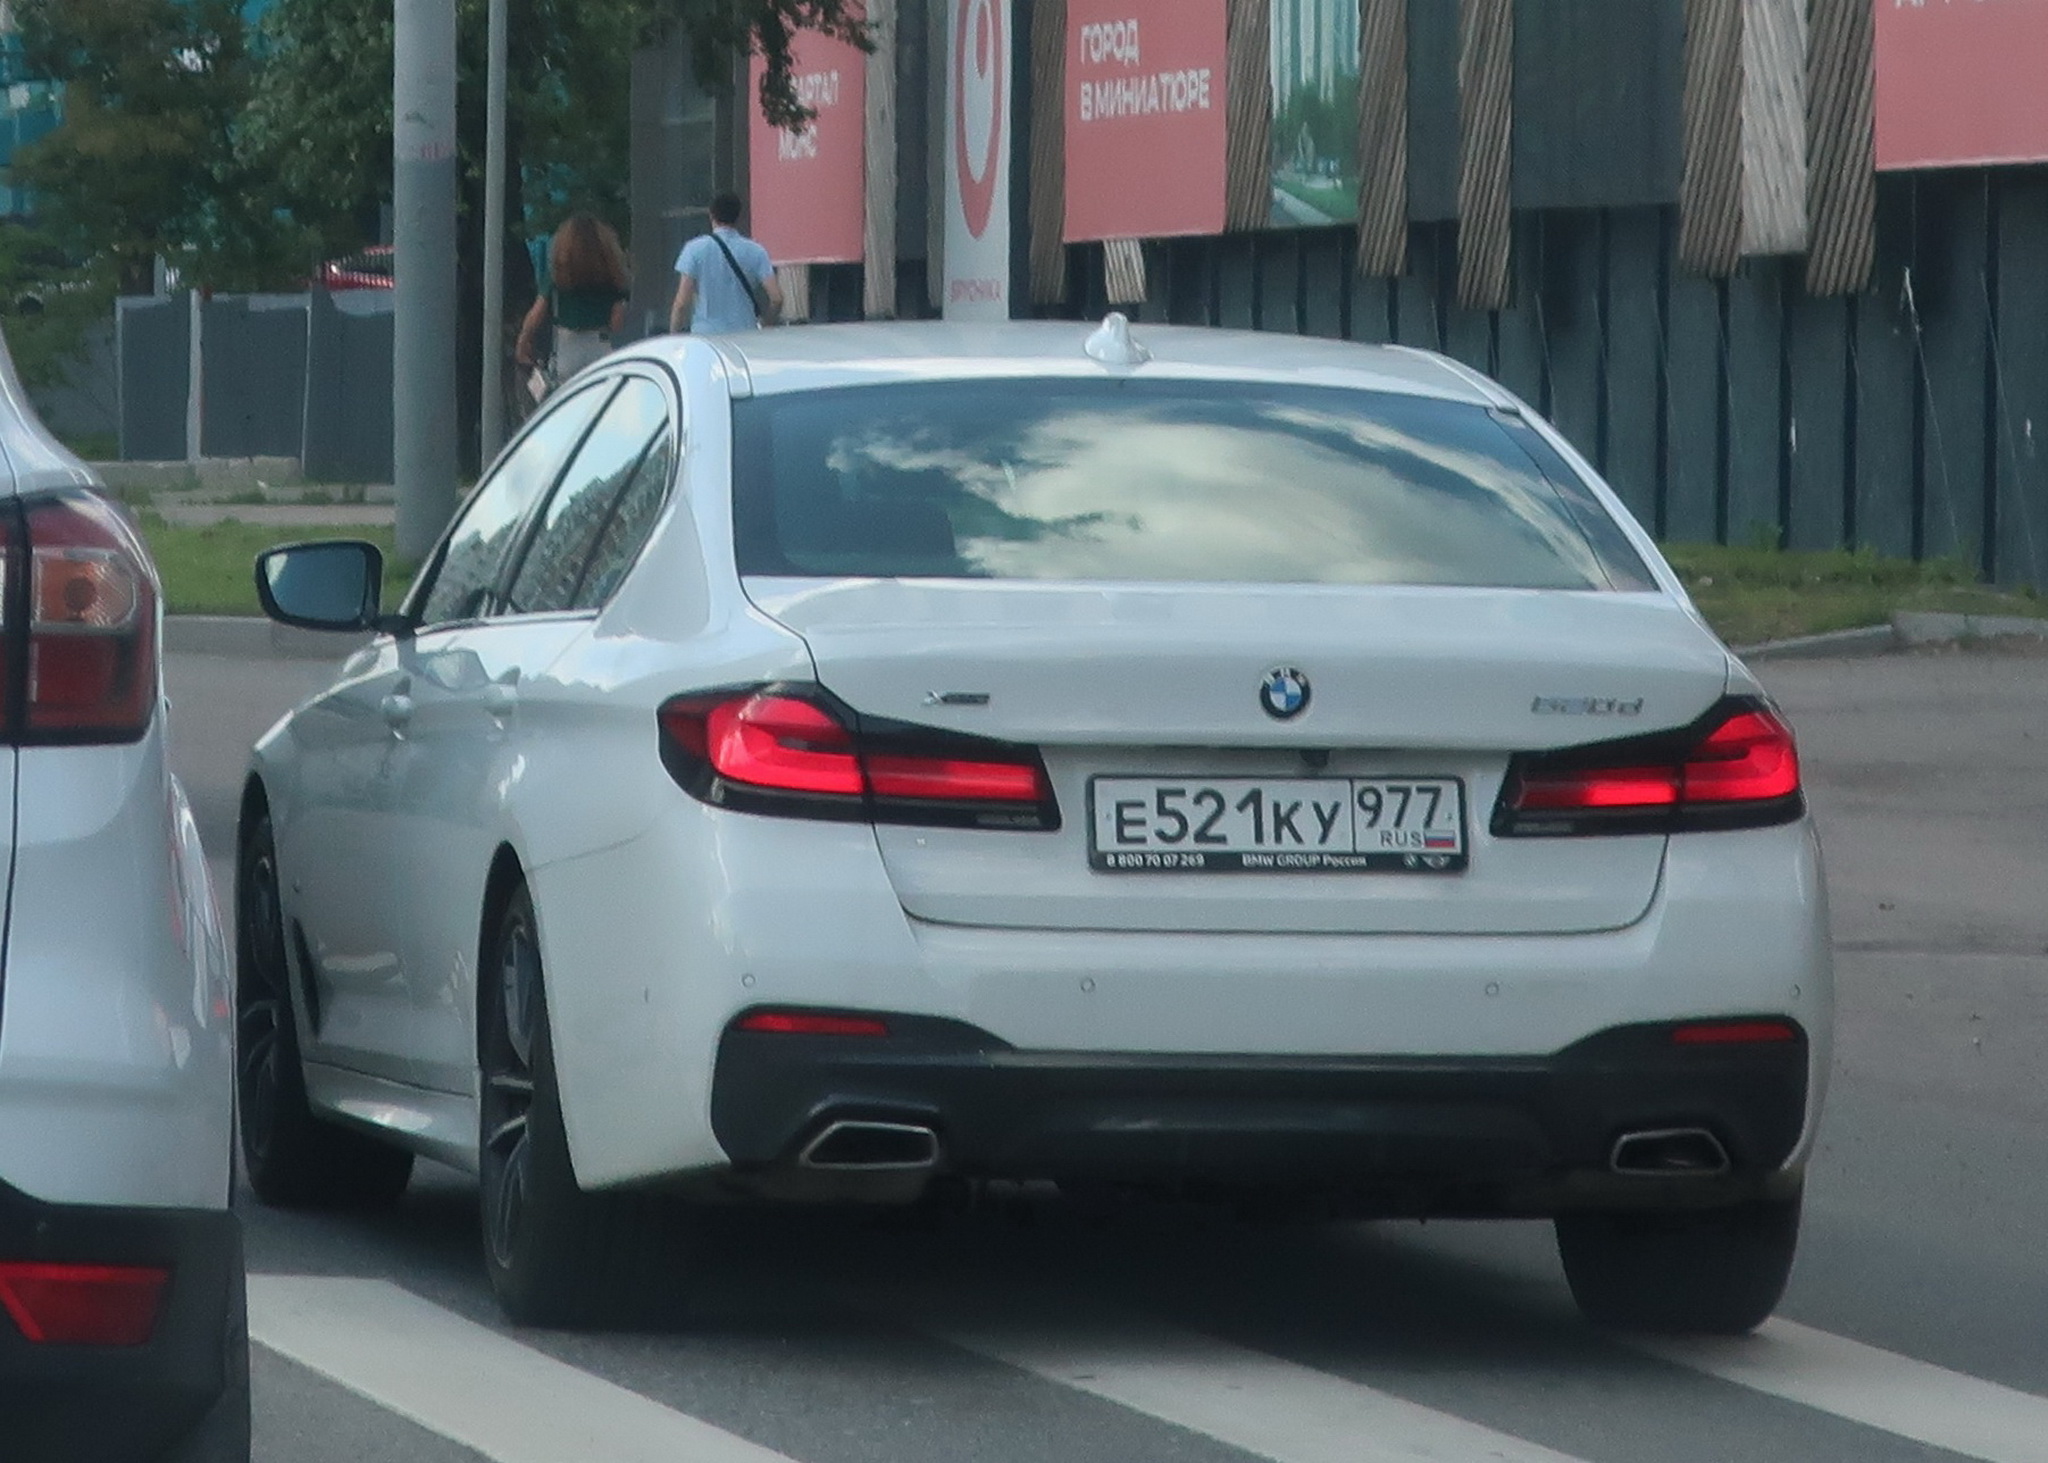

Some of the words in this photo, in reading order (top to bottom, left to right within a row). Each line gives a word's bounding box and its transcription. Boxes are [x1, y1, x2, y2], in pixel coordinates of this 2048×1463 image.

[1081, 19, 1139, 67] ГОРОД
[788, 69, 839, 106] АРТАЛ
[1081, 80, 1092, 121] В
[1095, 69, 1211, 119] МИНИАТЮРЕ
[1114, 787, 1340, 844] Е521КУ
[1358, 785, 1441, 828] 977
[1380, 830, 1422, 848] RUS
[1118, 854, 1143, 867] 800
[1145, 854, 1161, 867] 70
[1163, 854, 1179, 867] 07
[1242, 853, 1274, 866] BMW
[1277, 854, 1321, 867] GROUP
[1323, 854, 1367, 867] Россия
